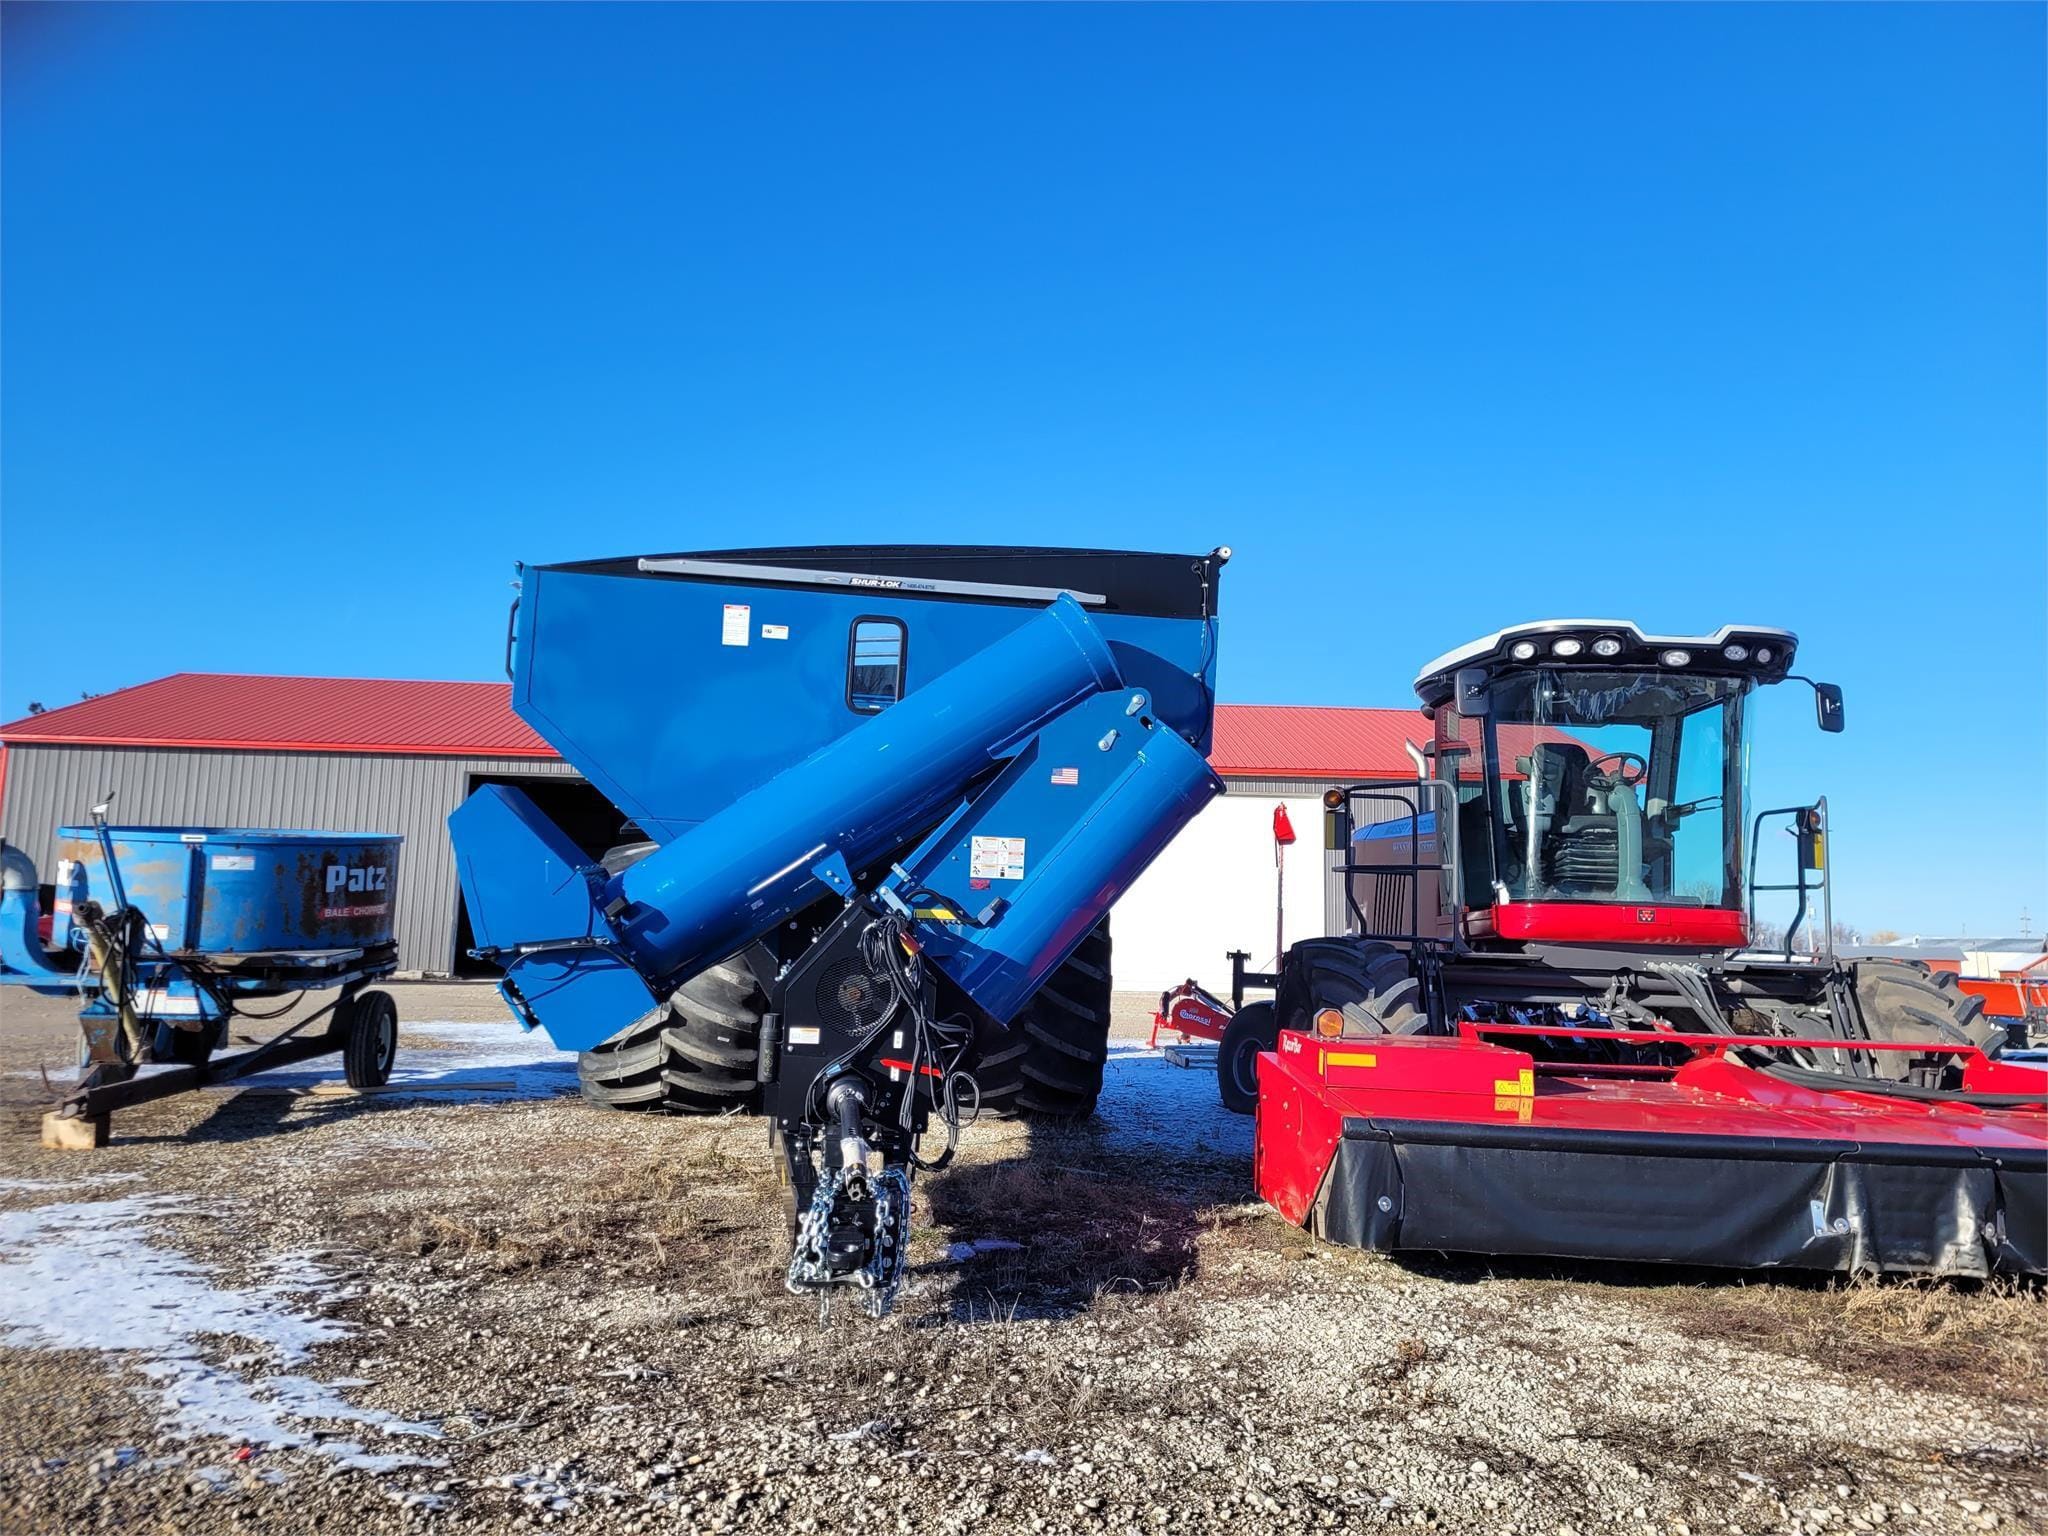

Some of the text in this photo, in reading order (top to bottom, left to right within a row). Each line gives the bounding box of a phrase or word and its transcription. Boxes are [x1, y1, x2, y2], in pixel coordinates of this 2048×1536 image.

[850, 577, 901, 588] SHUR-LOK
[325, 865, 387, 893] Patz
[324, 906, 351, 918] BALE
